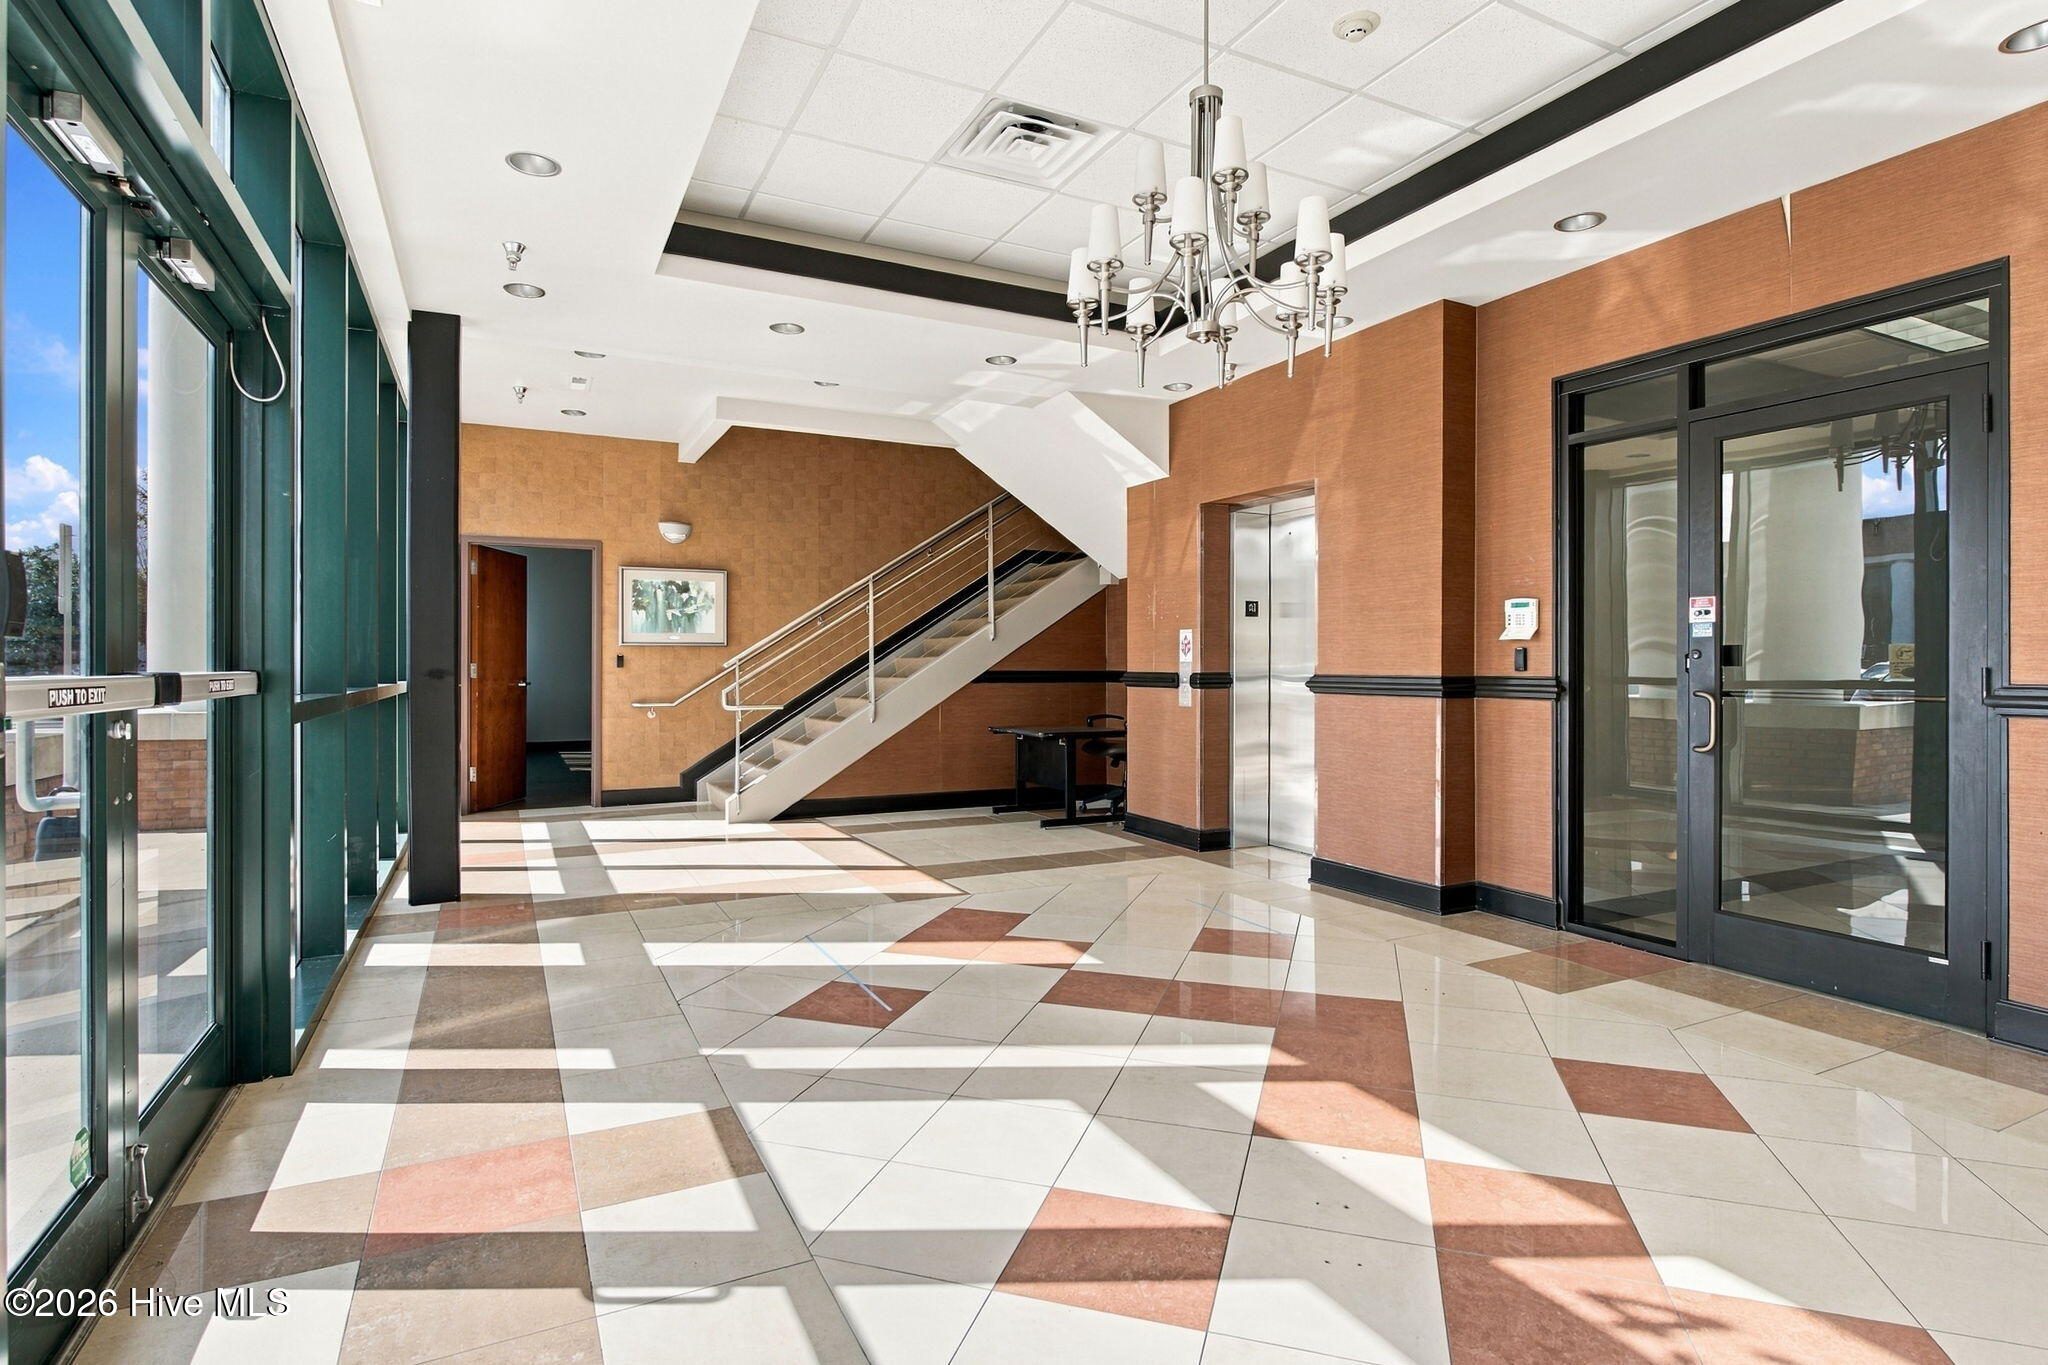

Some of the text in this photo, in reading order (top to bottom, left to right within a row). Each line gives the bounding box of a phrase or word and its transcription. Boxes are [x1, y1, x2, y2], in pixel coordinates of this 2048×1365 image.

[209, 681, 220, 692] PUSH
[49, 688, 106, 707] PUSH TO EXIT
